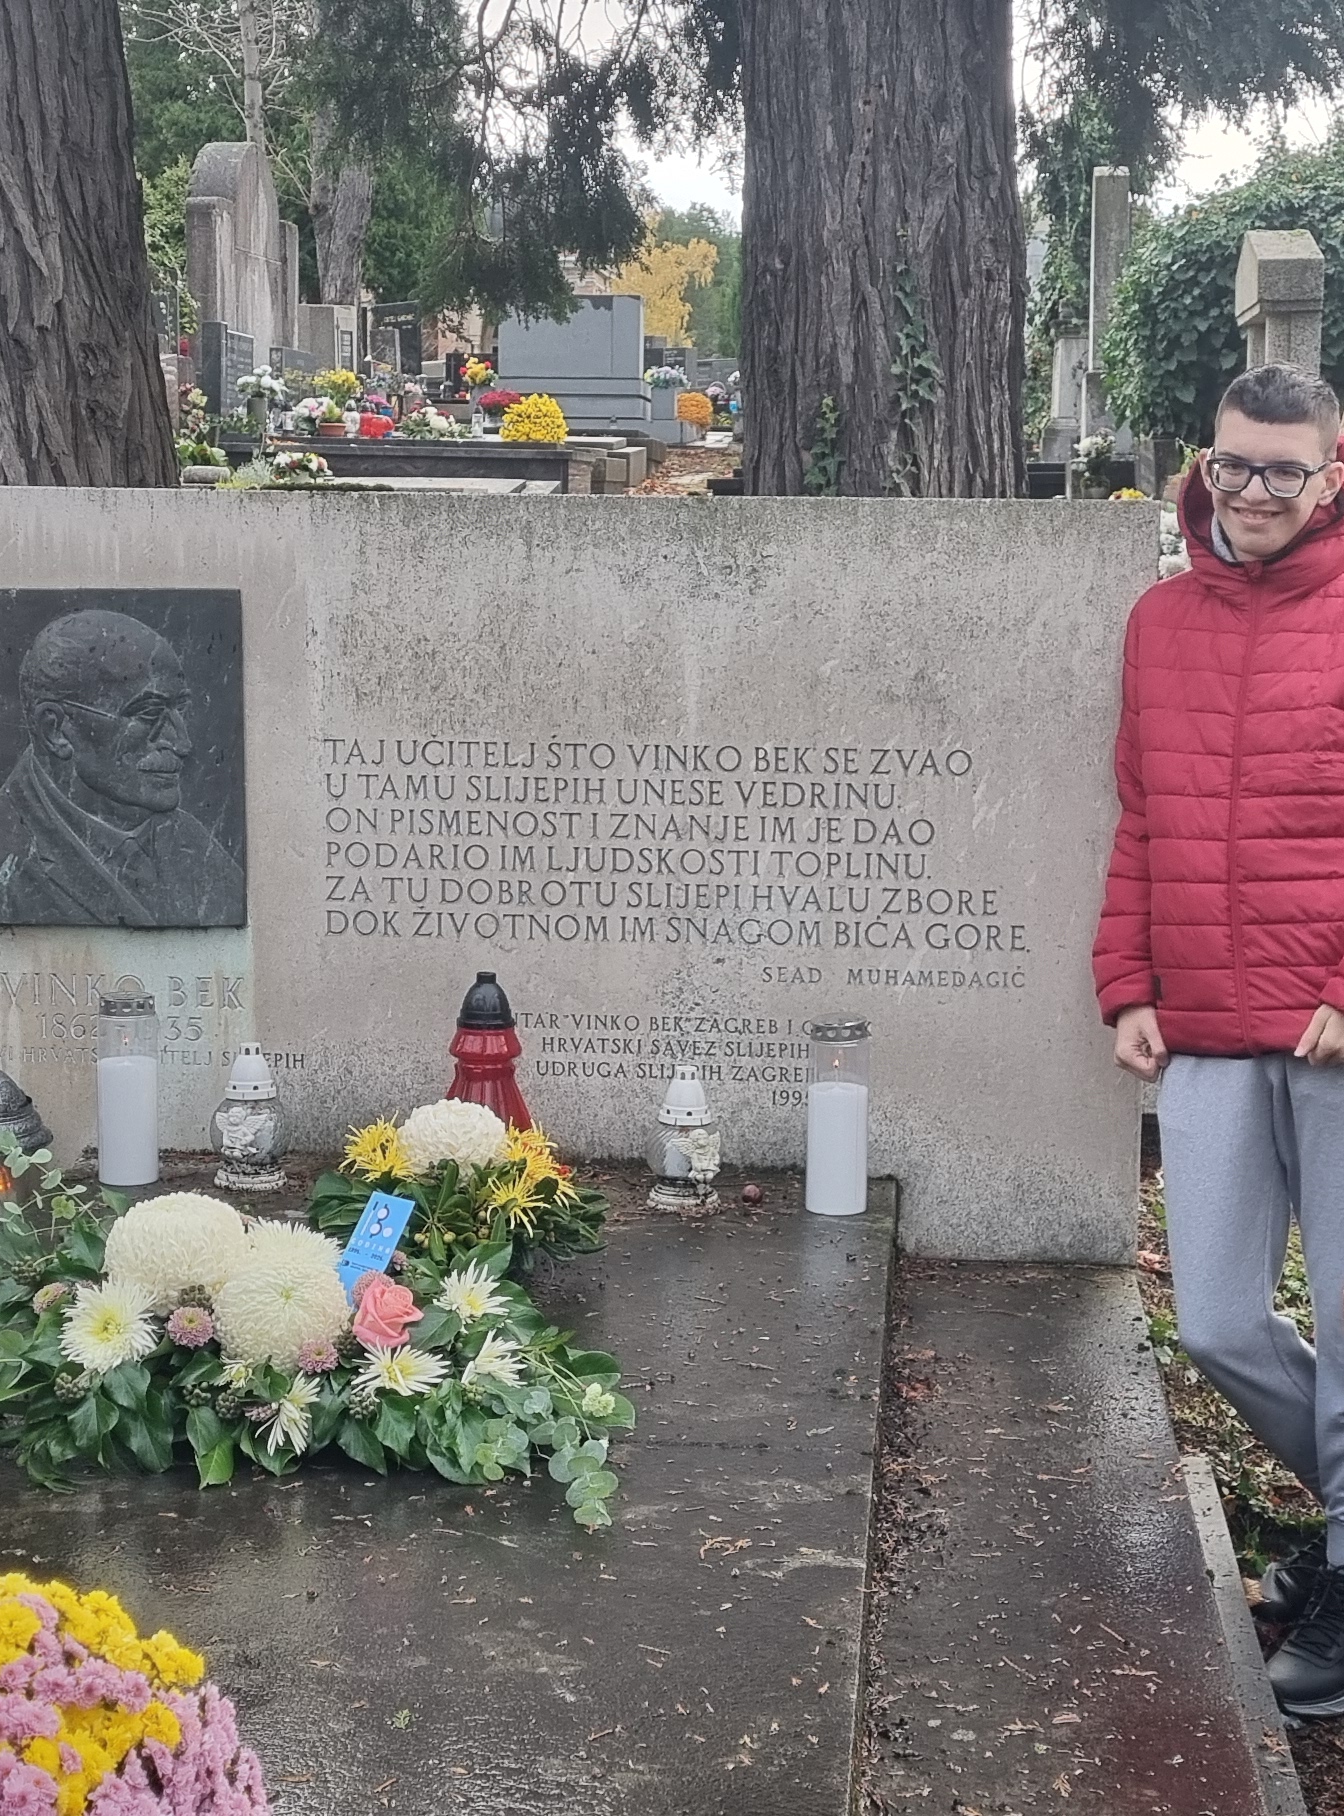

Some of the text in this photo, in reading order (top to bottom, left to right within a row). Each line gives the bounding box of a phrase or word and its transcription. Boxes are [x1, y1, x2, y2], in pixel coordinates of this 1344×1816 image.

[323, 733, 973, 777] TAJ UČITELJ ŠTO VINKO BEK SE ZVAO
[324, 773, 902, 809] U TAMU SLIJEPIH UNESE VEDRINU.
[325, 807, 935, 846] ON PISMENOST I ZNANJE IM JE DAO
[325, 841, 932, 880] PODARIO IM LJUDSKOSTI TOPLINU.
[325, 876, 998, 916] ZA TU DOBROTU SLIJEPI HVALU ZBORE
[324, 906, 1031, 952] DOK ŽIVOTNOM IM SNAGOM BIĆA GORE.
[165, 974, 246, 1011] BEK
[761, 966, 823, 985] SEAD
[694, 1016, 779, 1035] ZAGREB
[22, 1046, 98, 1064] HRVATS
[220, 1050, 306, 1069] SEPIH
[541, 1036, 810, 1059] HRVATSKI SAVEZ SLIJEPIH
[536, 1060, 628, 1079] UDRUGA
[636, 1062, 723, 1082] SLIJIH
[771, 1089, 809, 1107] 199
